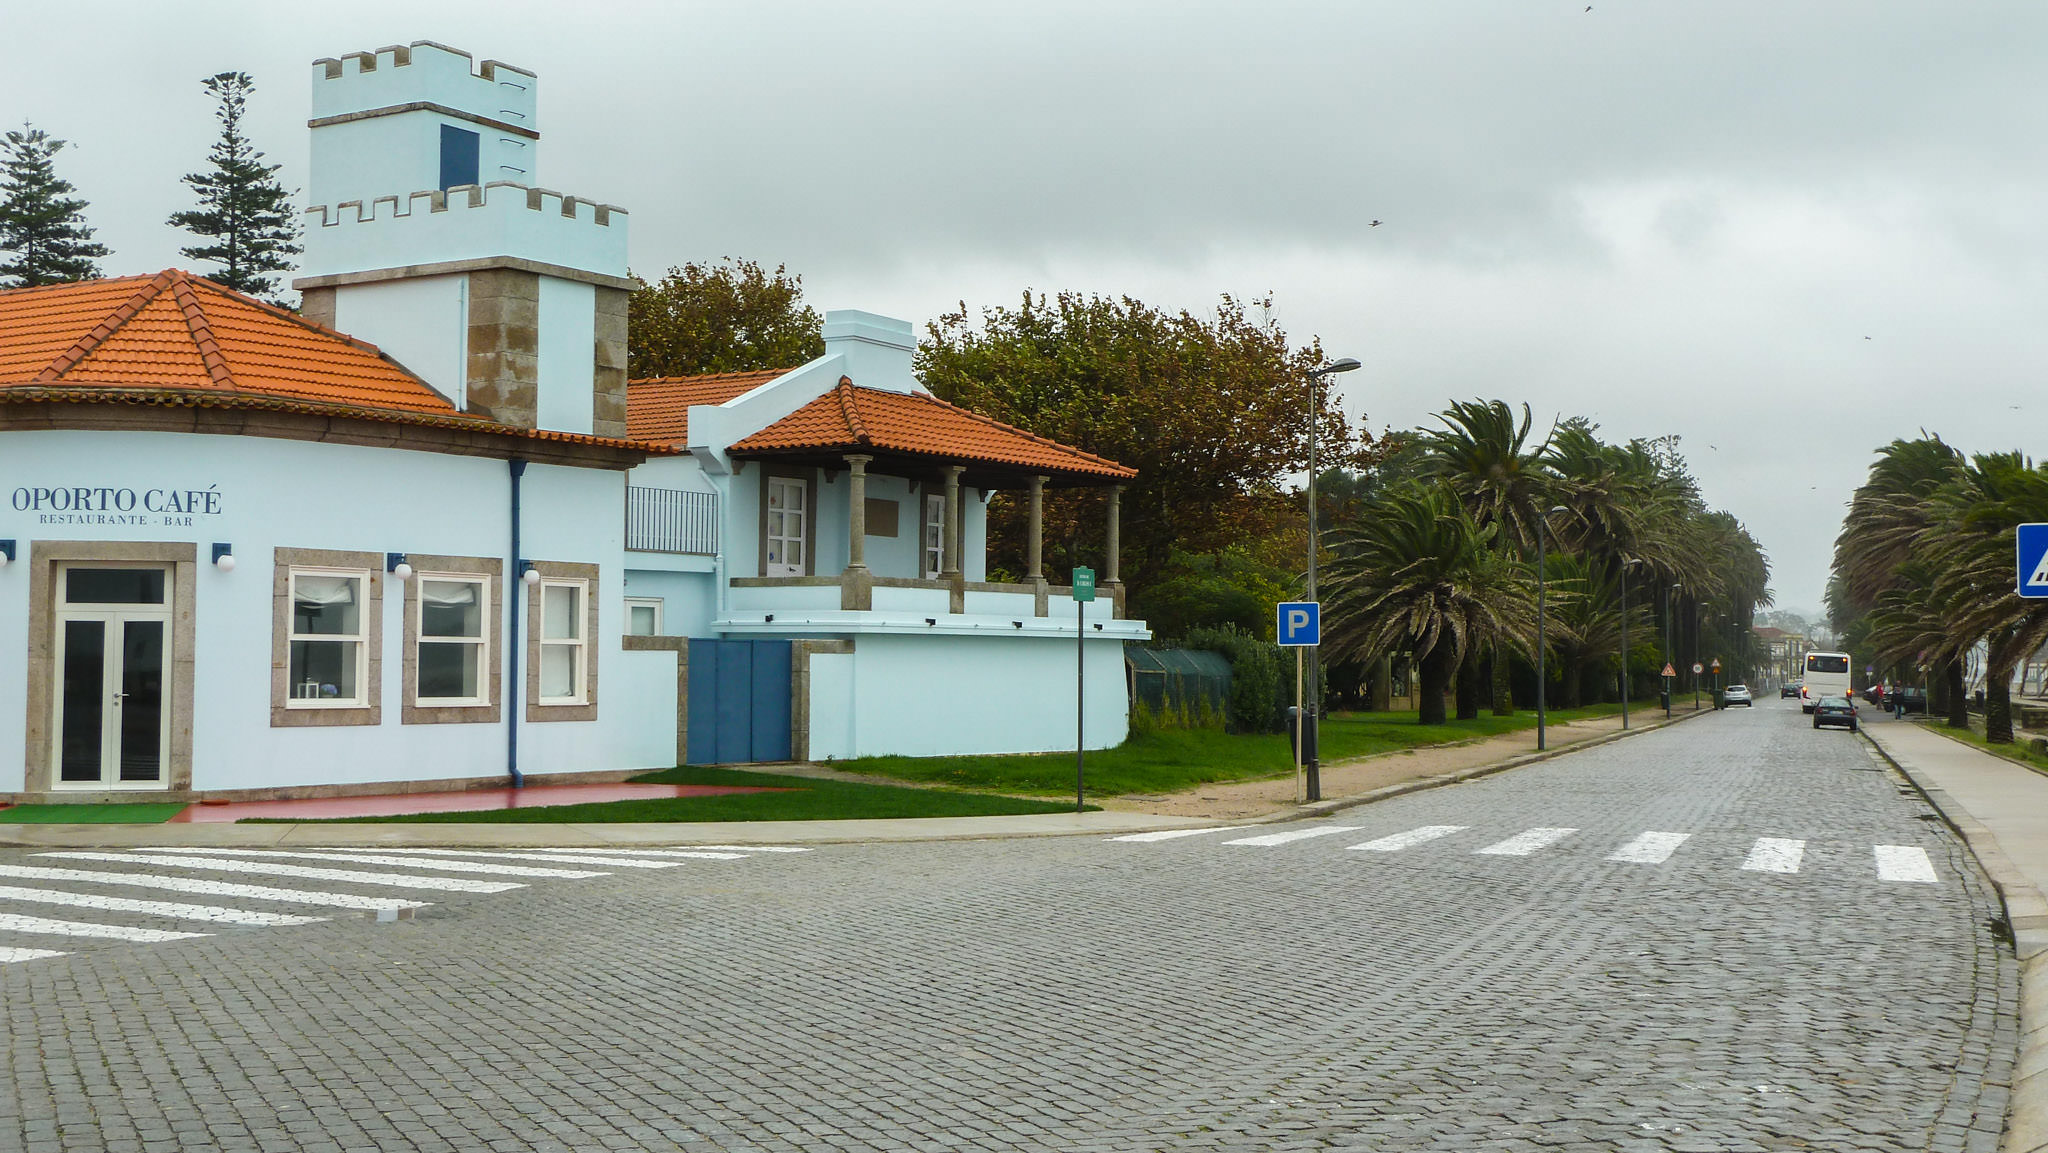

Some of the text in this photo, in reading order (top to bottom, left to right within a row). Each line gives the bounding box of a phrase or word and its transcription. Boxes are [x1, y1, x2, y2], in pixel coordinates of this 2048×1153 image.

[12, 483, 222, 515] OPORTO CAFÉ
[39, 514, 147, 526] RESTAURANTE
[164, 516, 193, 527] BAR
[1288, 609, 1310, 638] P
